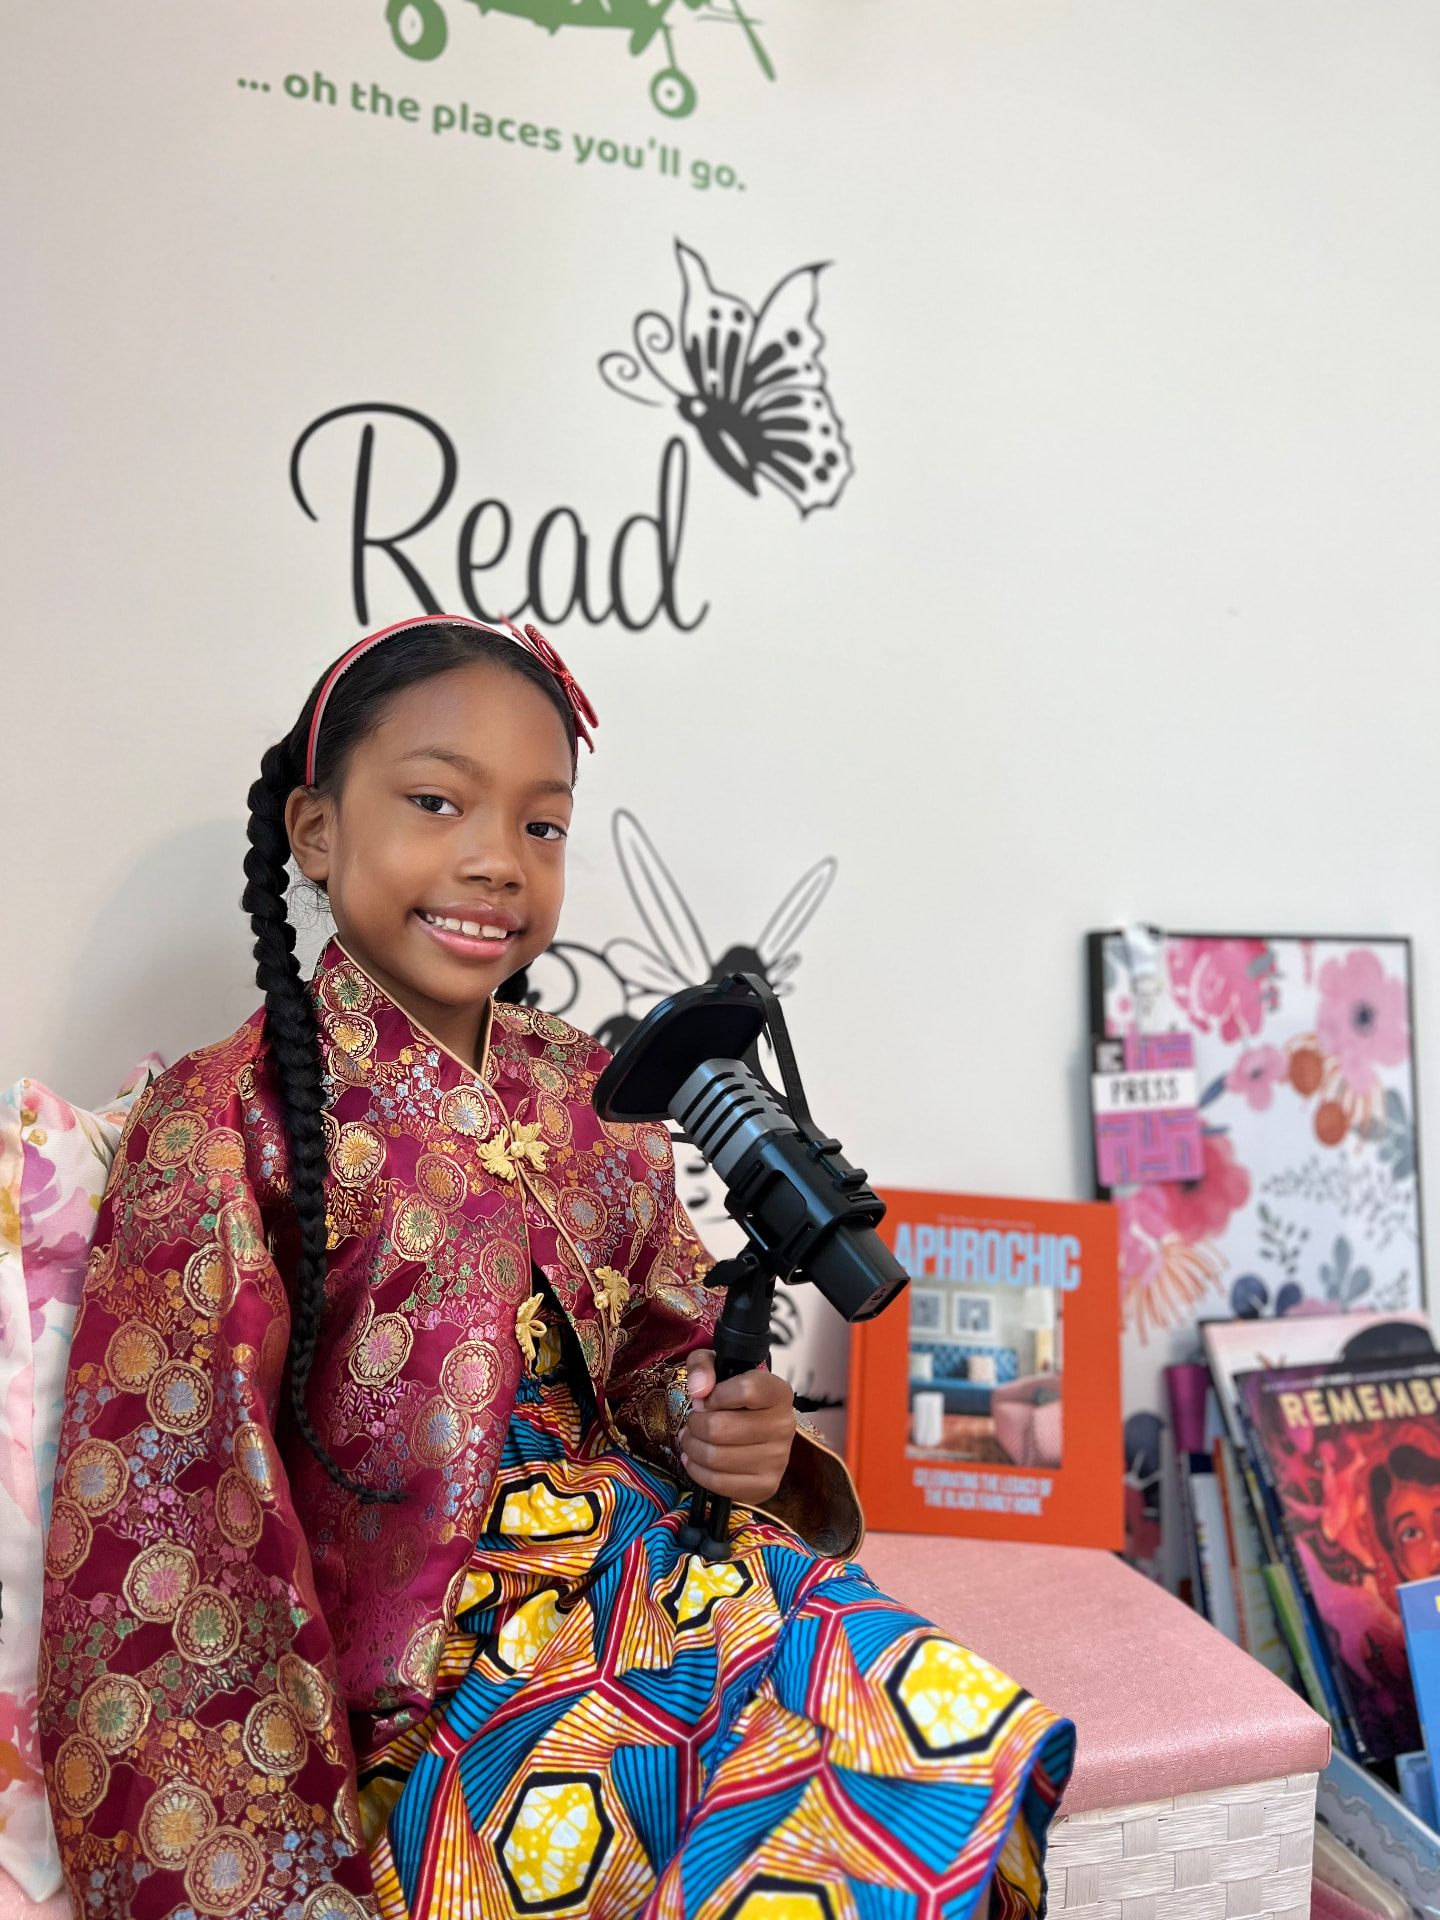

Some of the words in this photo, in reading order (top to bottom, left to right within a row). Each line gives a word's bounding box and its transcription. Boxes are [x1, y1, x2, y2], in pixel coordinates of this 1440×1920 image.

[283, 70, 337, 106] oh
[351, 81, 420, 122] the
[432, 102, 562, 152] places
[572, 137, 680, 178] you'll
[690, 159, 747, 191] go.
[290, 402, 709, 633] Read
[1110, 1077, 1180, 1106] PRESS
[893, 1222, 1081, 1291] APHROCHIC
